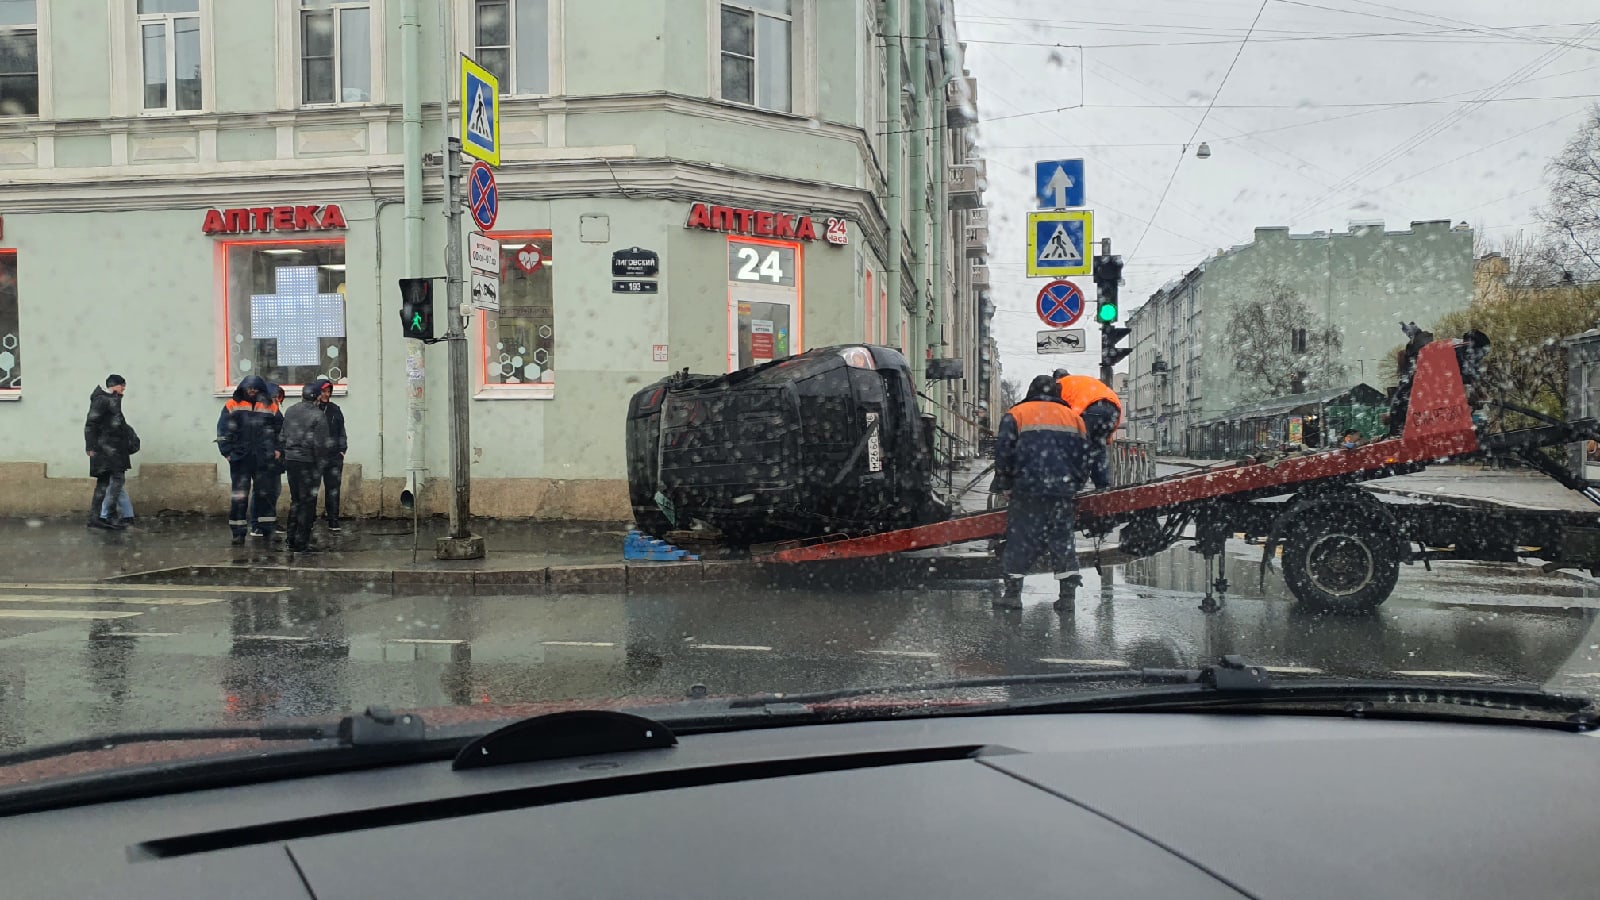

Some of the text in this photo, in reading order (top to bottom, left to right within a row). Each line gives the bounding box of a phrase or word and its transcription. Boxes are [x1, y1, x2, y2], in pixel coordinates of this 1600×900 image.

[202, 205, 346, 233] АПТЕКА
[686, 203, 816, 240] АПТЕКА
[829, 218, 847, 234] 24
[615, 258, 656, 267] ЛИГОВСКИЙ
[737, 248, 783, 282] 24
[629, 282, 641, 291] 193
